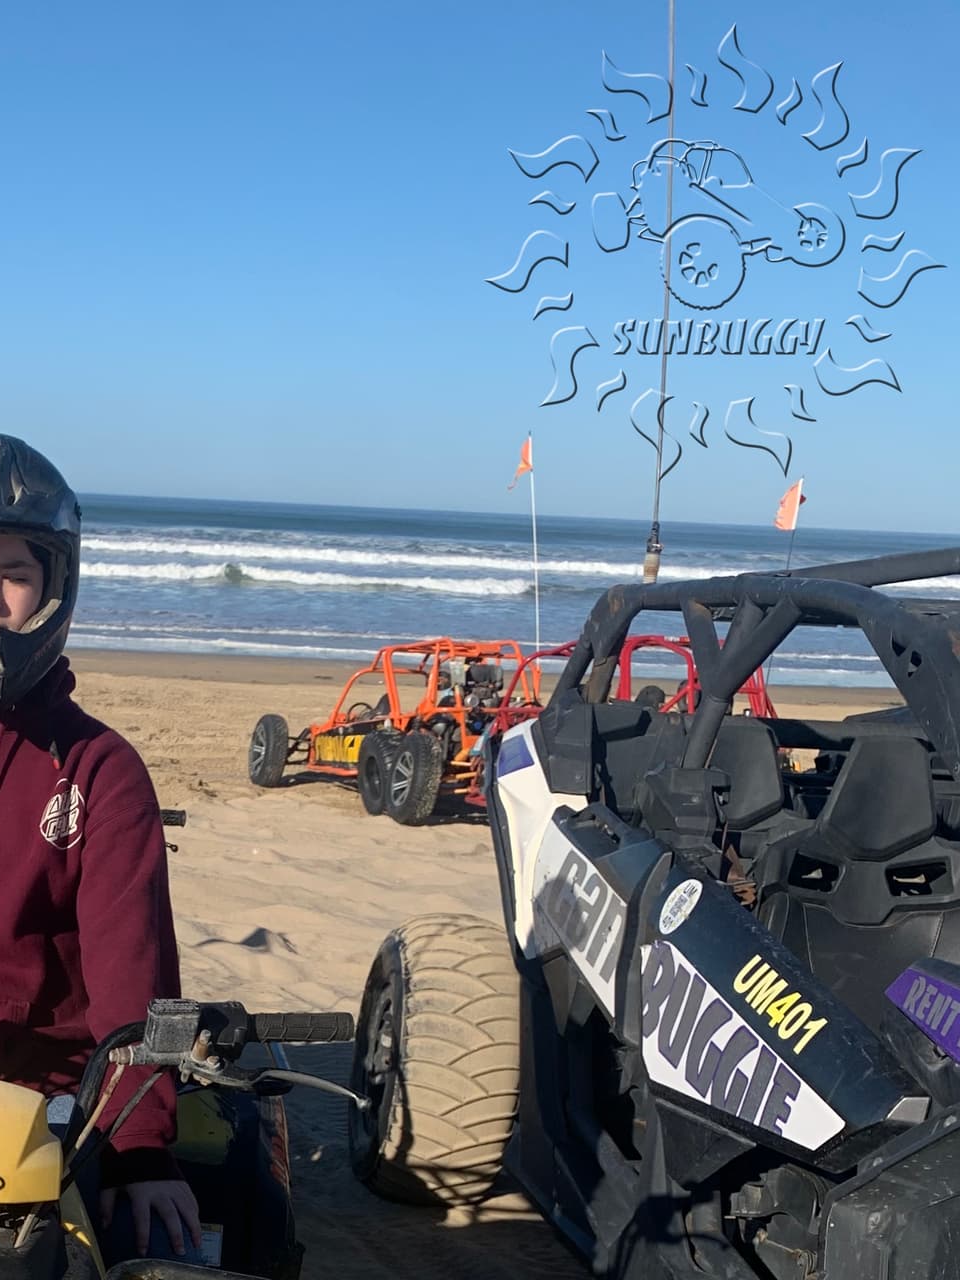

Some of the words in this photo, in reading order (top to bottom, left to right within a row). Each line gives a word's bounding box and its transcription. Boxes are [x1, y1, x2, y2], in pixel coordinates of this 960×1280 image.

[642, 940, 802, 1137] BUGGIE
[732, 954, 829, 1056] UM401
[902, 976, 960, 1037] RENT
